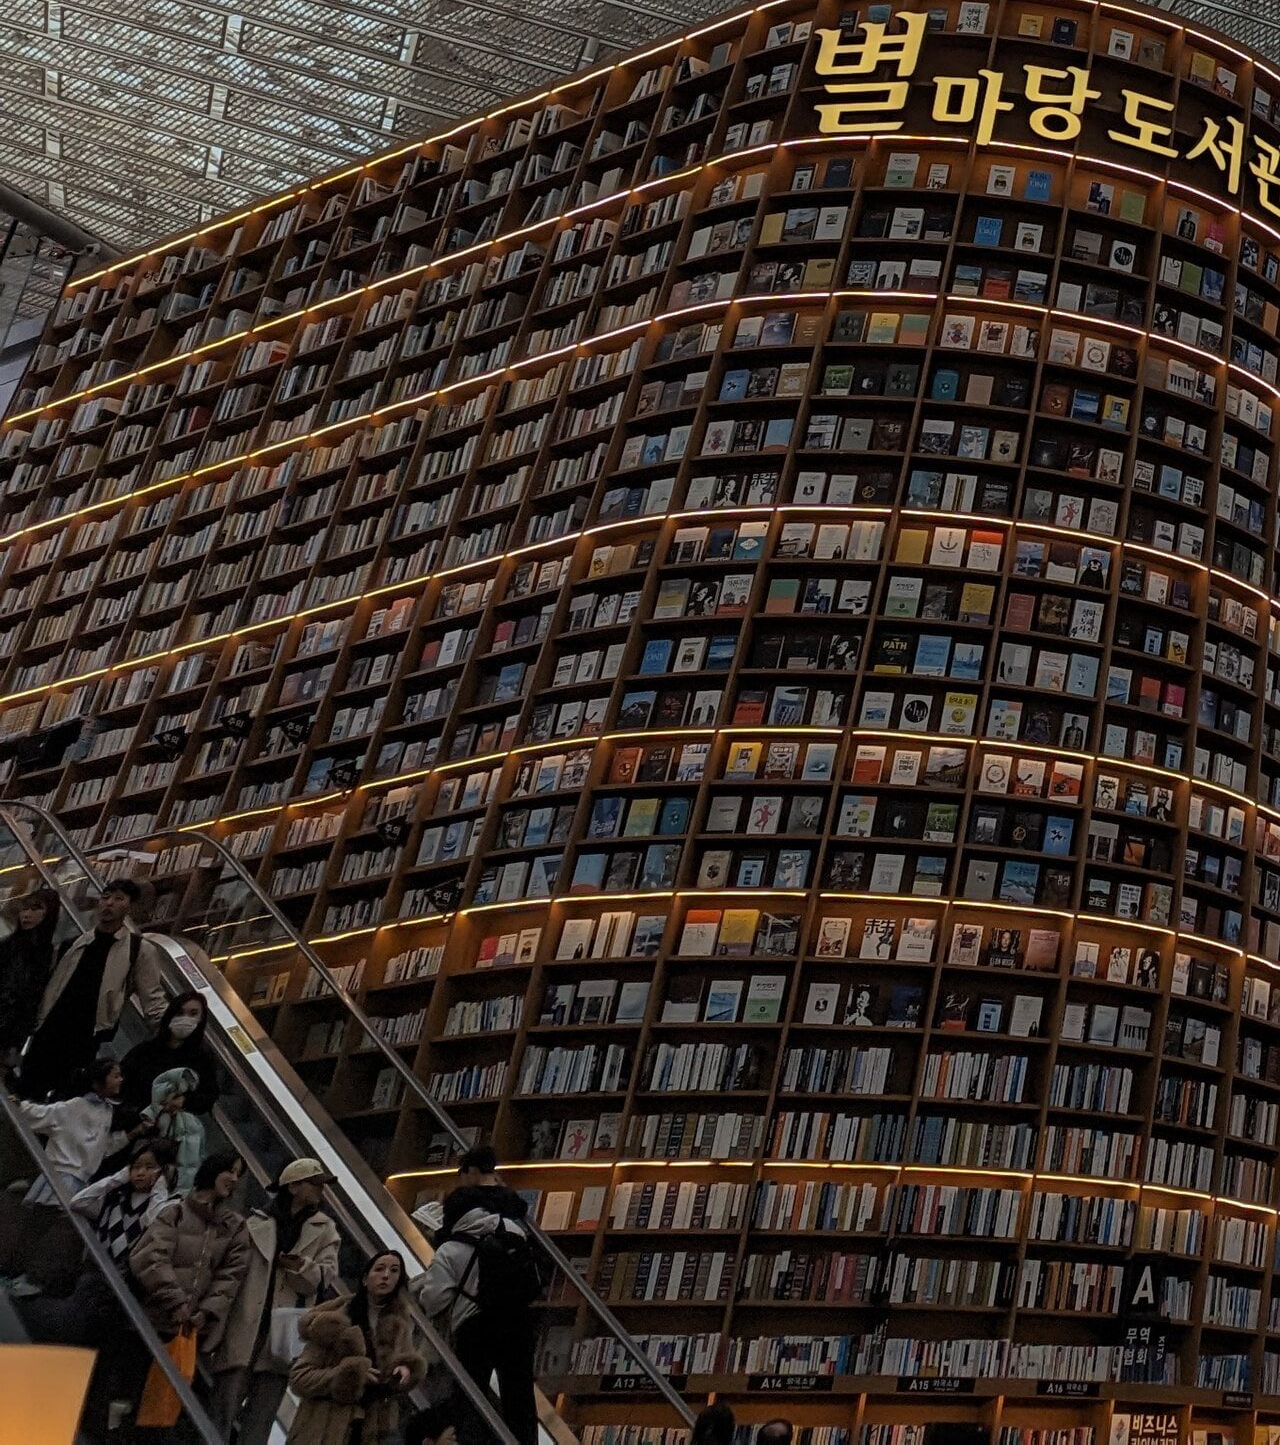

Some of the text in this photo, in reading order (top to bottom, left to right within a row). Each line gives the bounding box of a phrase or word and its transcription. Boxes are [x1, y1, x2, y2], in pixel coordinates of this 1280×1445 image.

[882, 640, 908, 652] PATH
[1131, 1265, 1155, 1305] A
[1126, 1326, 1151, 1344] 무역
[1123, 1348, 1148, 1366] 협회
[1156, 1335, 1166, 1362] KITA
[613, 1377, 635, 1389] A13
[760, 1377, 782, 1390] A14
[909, 1379, 930, 1391] A15
[1131, 1413, 1179, 1437] 비즈니스
